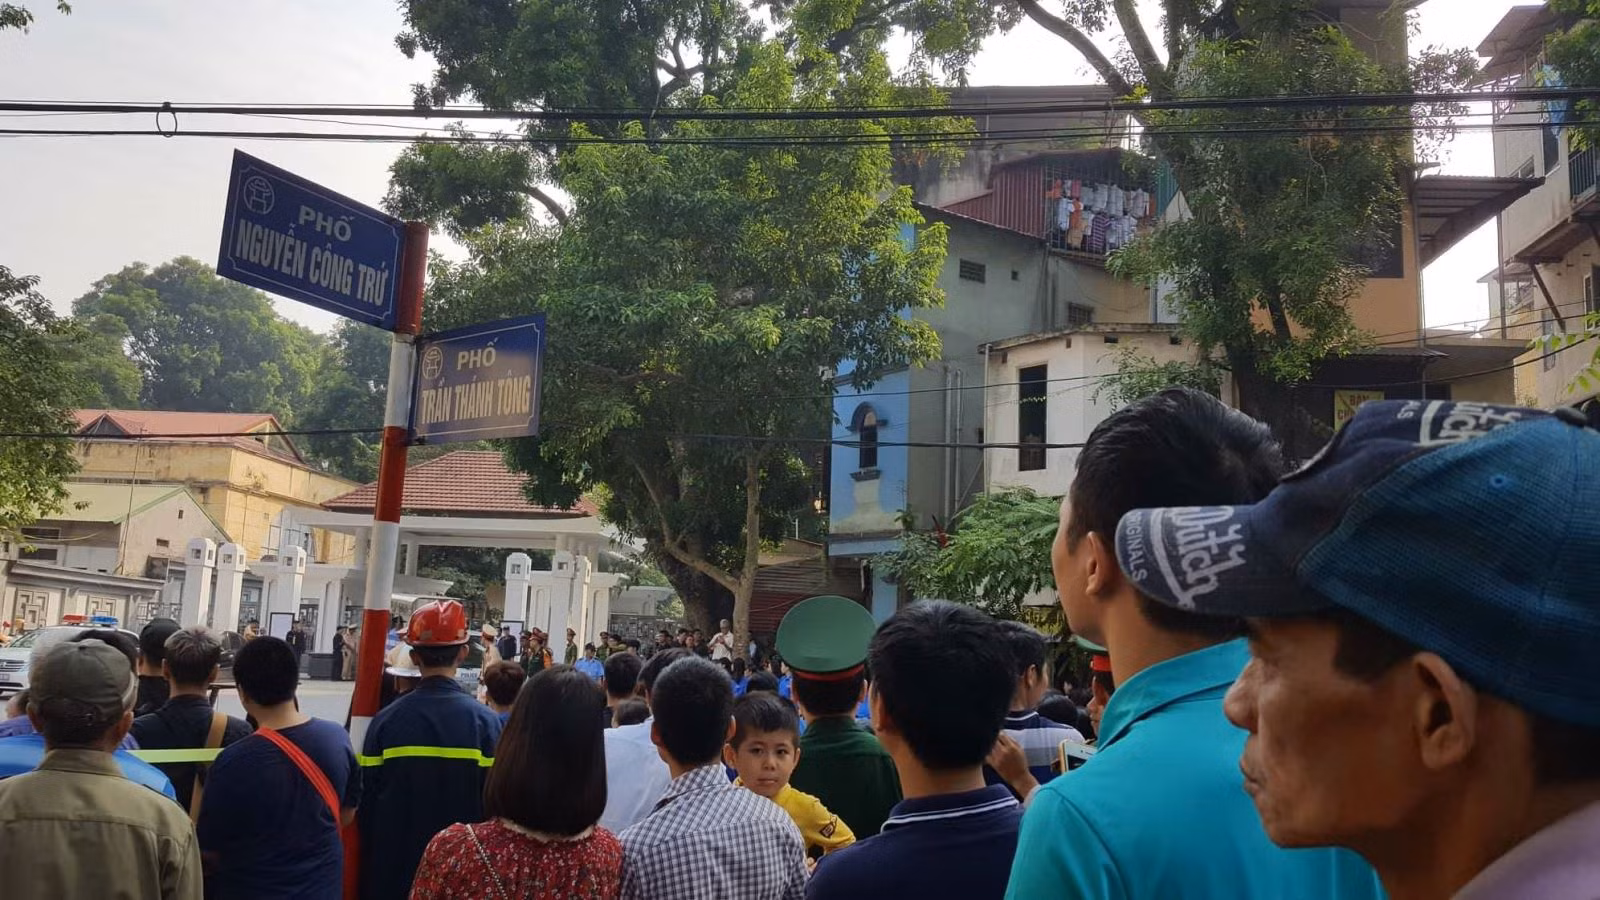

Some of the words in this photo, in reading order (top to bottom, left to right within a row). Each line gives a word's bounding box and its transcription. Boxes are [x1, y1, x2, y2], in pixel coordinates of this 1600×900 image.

[299, 205, 353, 241] PHỐ
[236, 219, 307, 279] NGUYỄN
[309, 243, 353, 295] CÔNG
[356, 261, 388, 306] TRỨ
[457, 337, 498, 370] PHỐ
[455, 375, 494, 421] THÁNH
[497, 369, 531, 416] TÔNG
